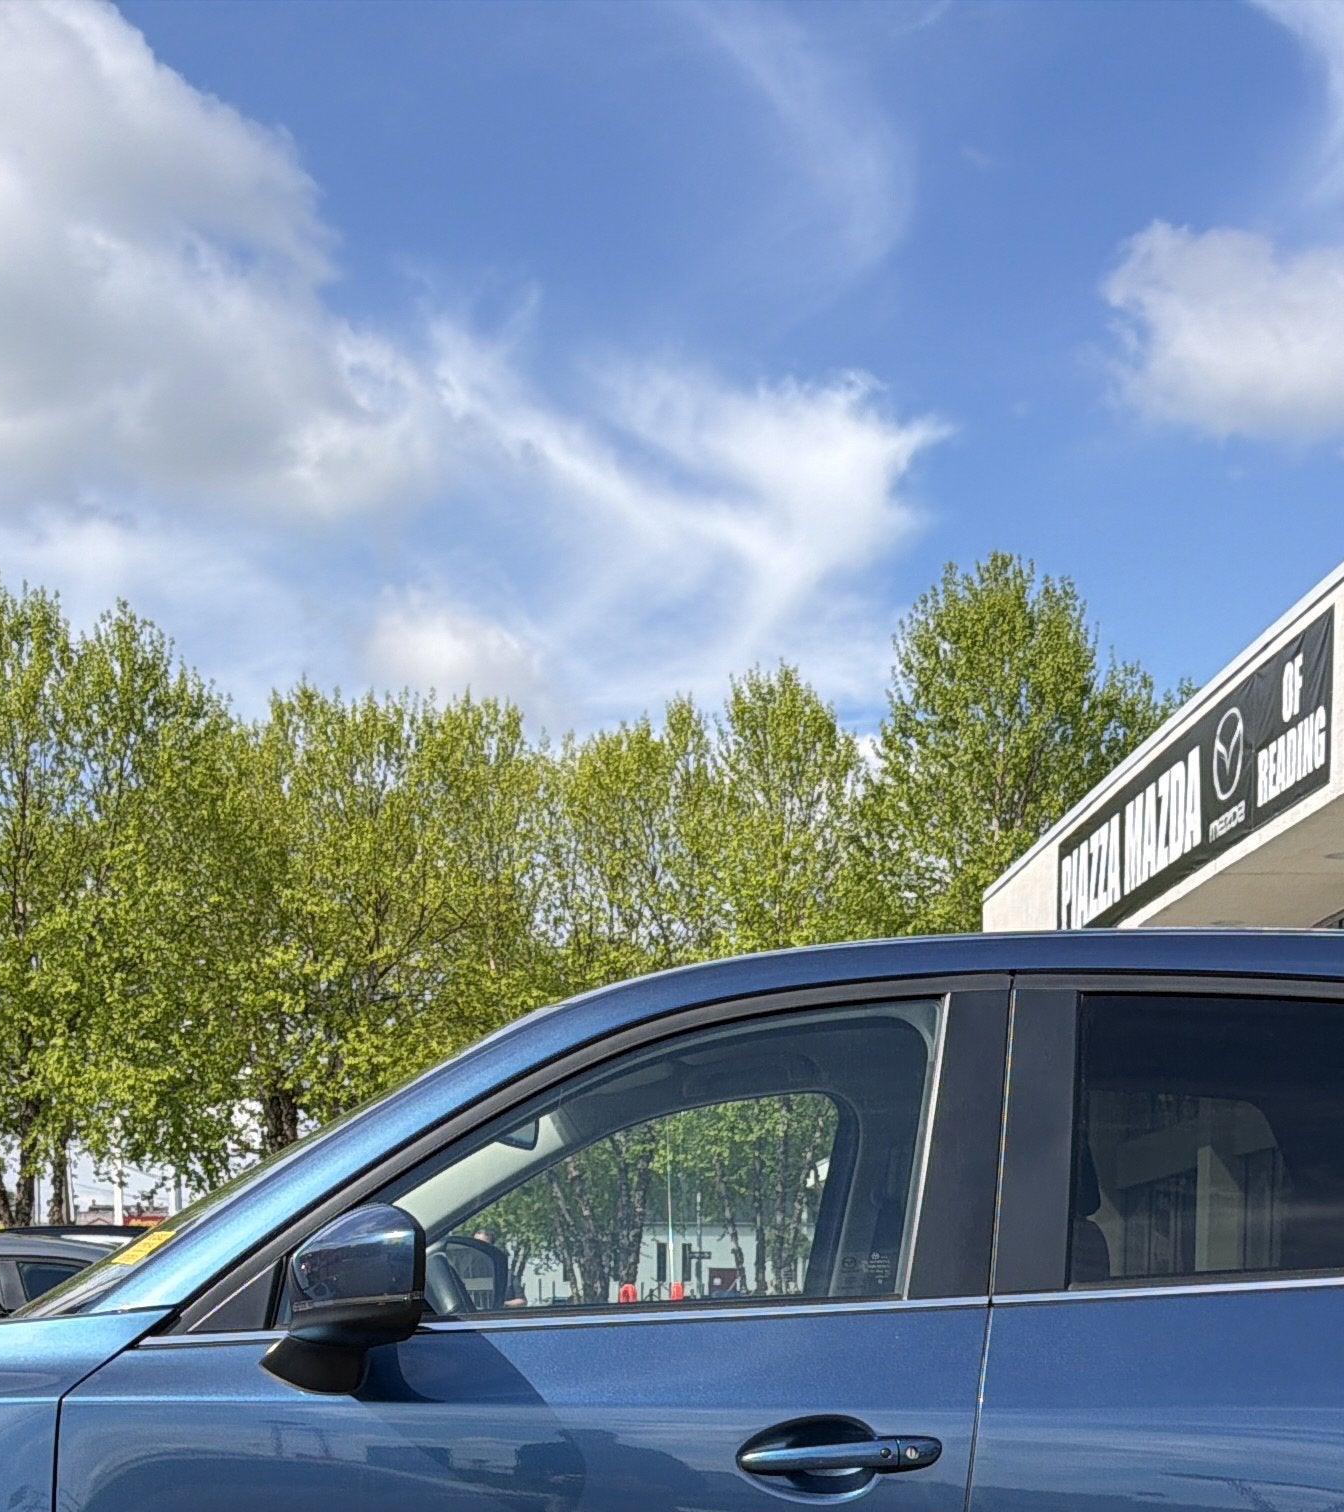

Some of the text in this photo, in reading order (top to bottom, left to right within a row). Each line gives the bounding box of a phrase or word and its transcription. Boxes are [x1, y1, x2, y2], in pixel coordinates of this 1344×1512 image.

[1282, 652, 1304, 723] OF
[1257, 705, 1327, 808] READING
[1061, 745, 1201, 930] PIAZZA MAZDA
[1209, 800, 1246, 843] mazda
